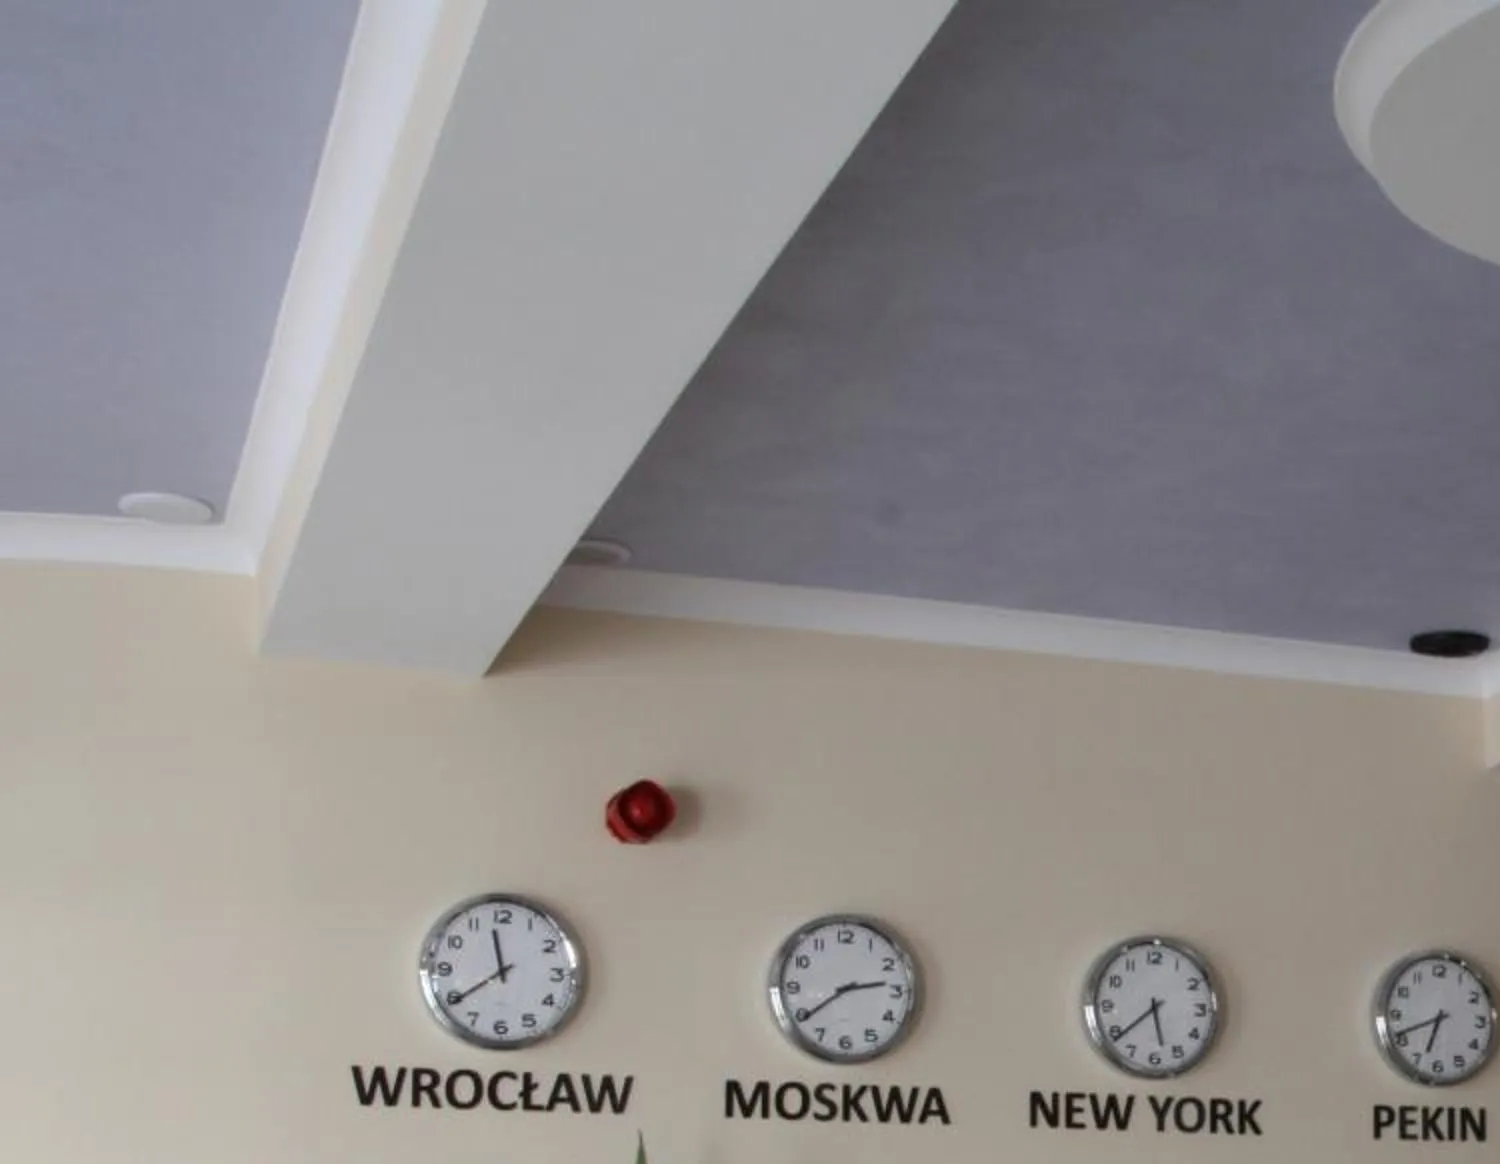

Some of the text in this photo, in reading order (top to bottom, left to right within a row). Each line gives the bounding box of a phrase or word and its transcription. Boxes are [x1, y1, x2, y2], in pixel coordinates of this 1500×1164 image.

[493, 909, 513, 924] 12
[469, 917, 479, 932] 11
[528, 918, 533, 931] 1
[448, 935, 463, 949] 10
[837, 929, 855, 944] 12
[543, 939, 557, 953] 2
[814, 938, 824, 952] 11
[869, 937, 873, 952] 1
[438, 961, 453, 976] 9
[796, 955, 810, 969] 10
[882, 957, 895, 971] 2
[550, 968, 564, 982] 3
[787, 981, 800, 994] 9
[889, 984, 902, 999] 3
[542, 994, 555, 1007] 4
[467, 1011, 479, 1026] 7
[521, 1013, 536, 1028] 5
[882, 1010, 896, 1022] 4
[493, 1020, 509, 1035] 6
[815, 1027, 826, 1042] 7
[839, 1035, 852, 1050] 6
[864, 1029, 878, 1042] 5
[352, 1066, 633, 1114] WROCŁAW
[726, 1081, 950, 1124] MOSKWA
[1030, 1092, 1261, 1135] NEW YORK
[1374, 1105, 1486, 1142] PEKIN
